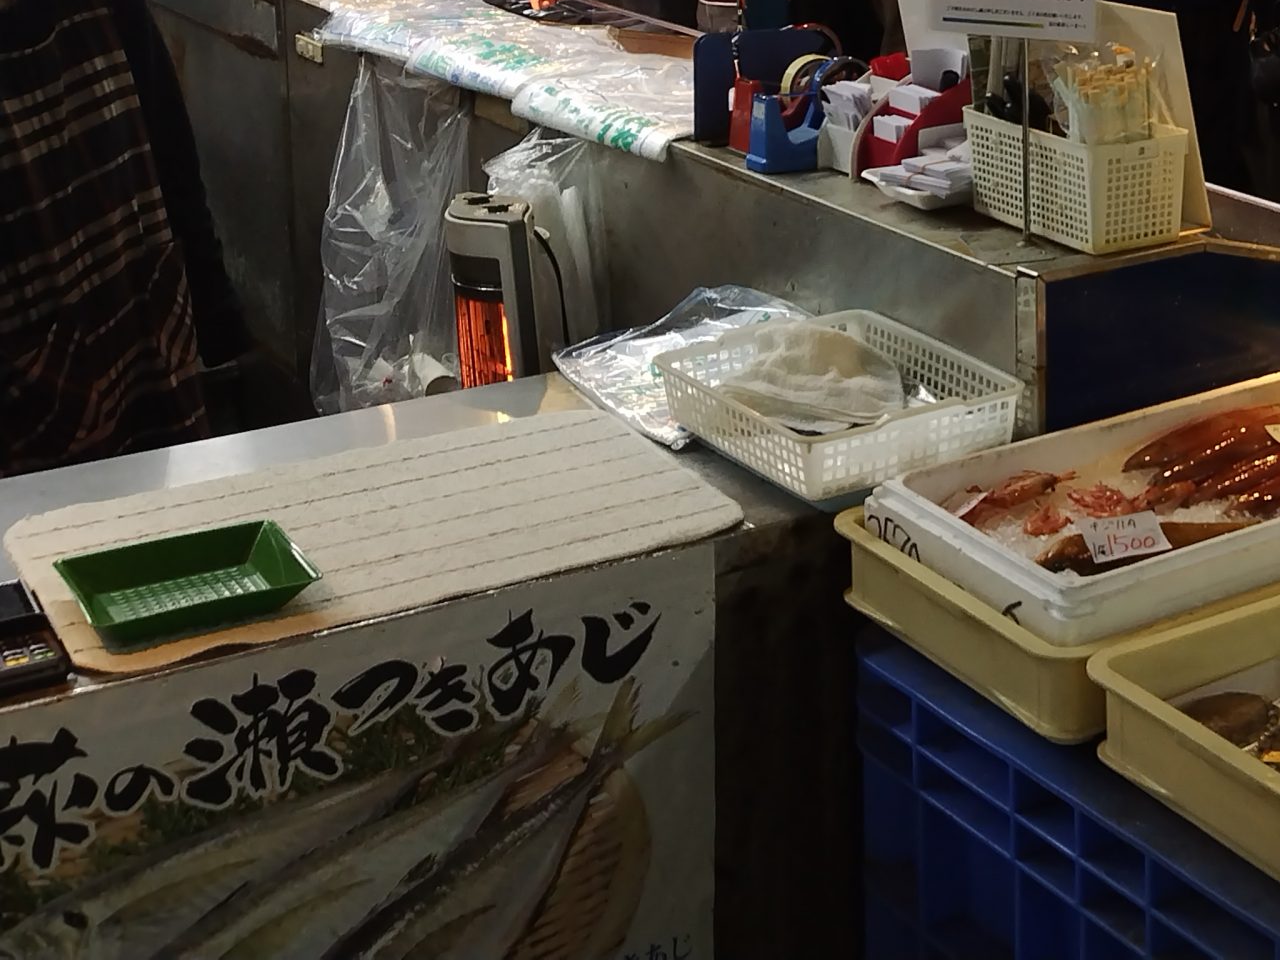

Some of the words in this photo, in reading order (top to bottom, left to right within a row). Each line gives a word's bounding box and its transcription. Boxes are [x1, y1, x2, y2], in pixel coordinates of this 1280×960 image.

[0, 602, 663, 870] 萩の瀬つきあじ
